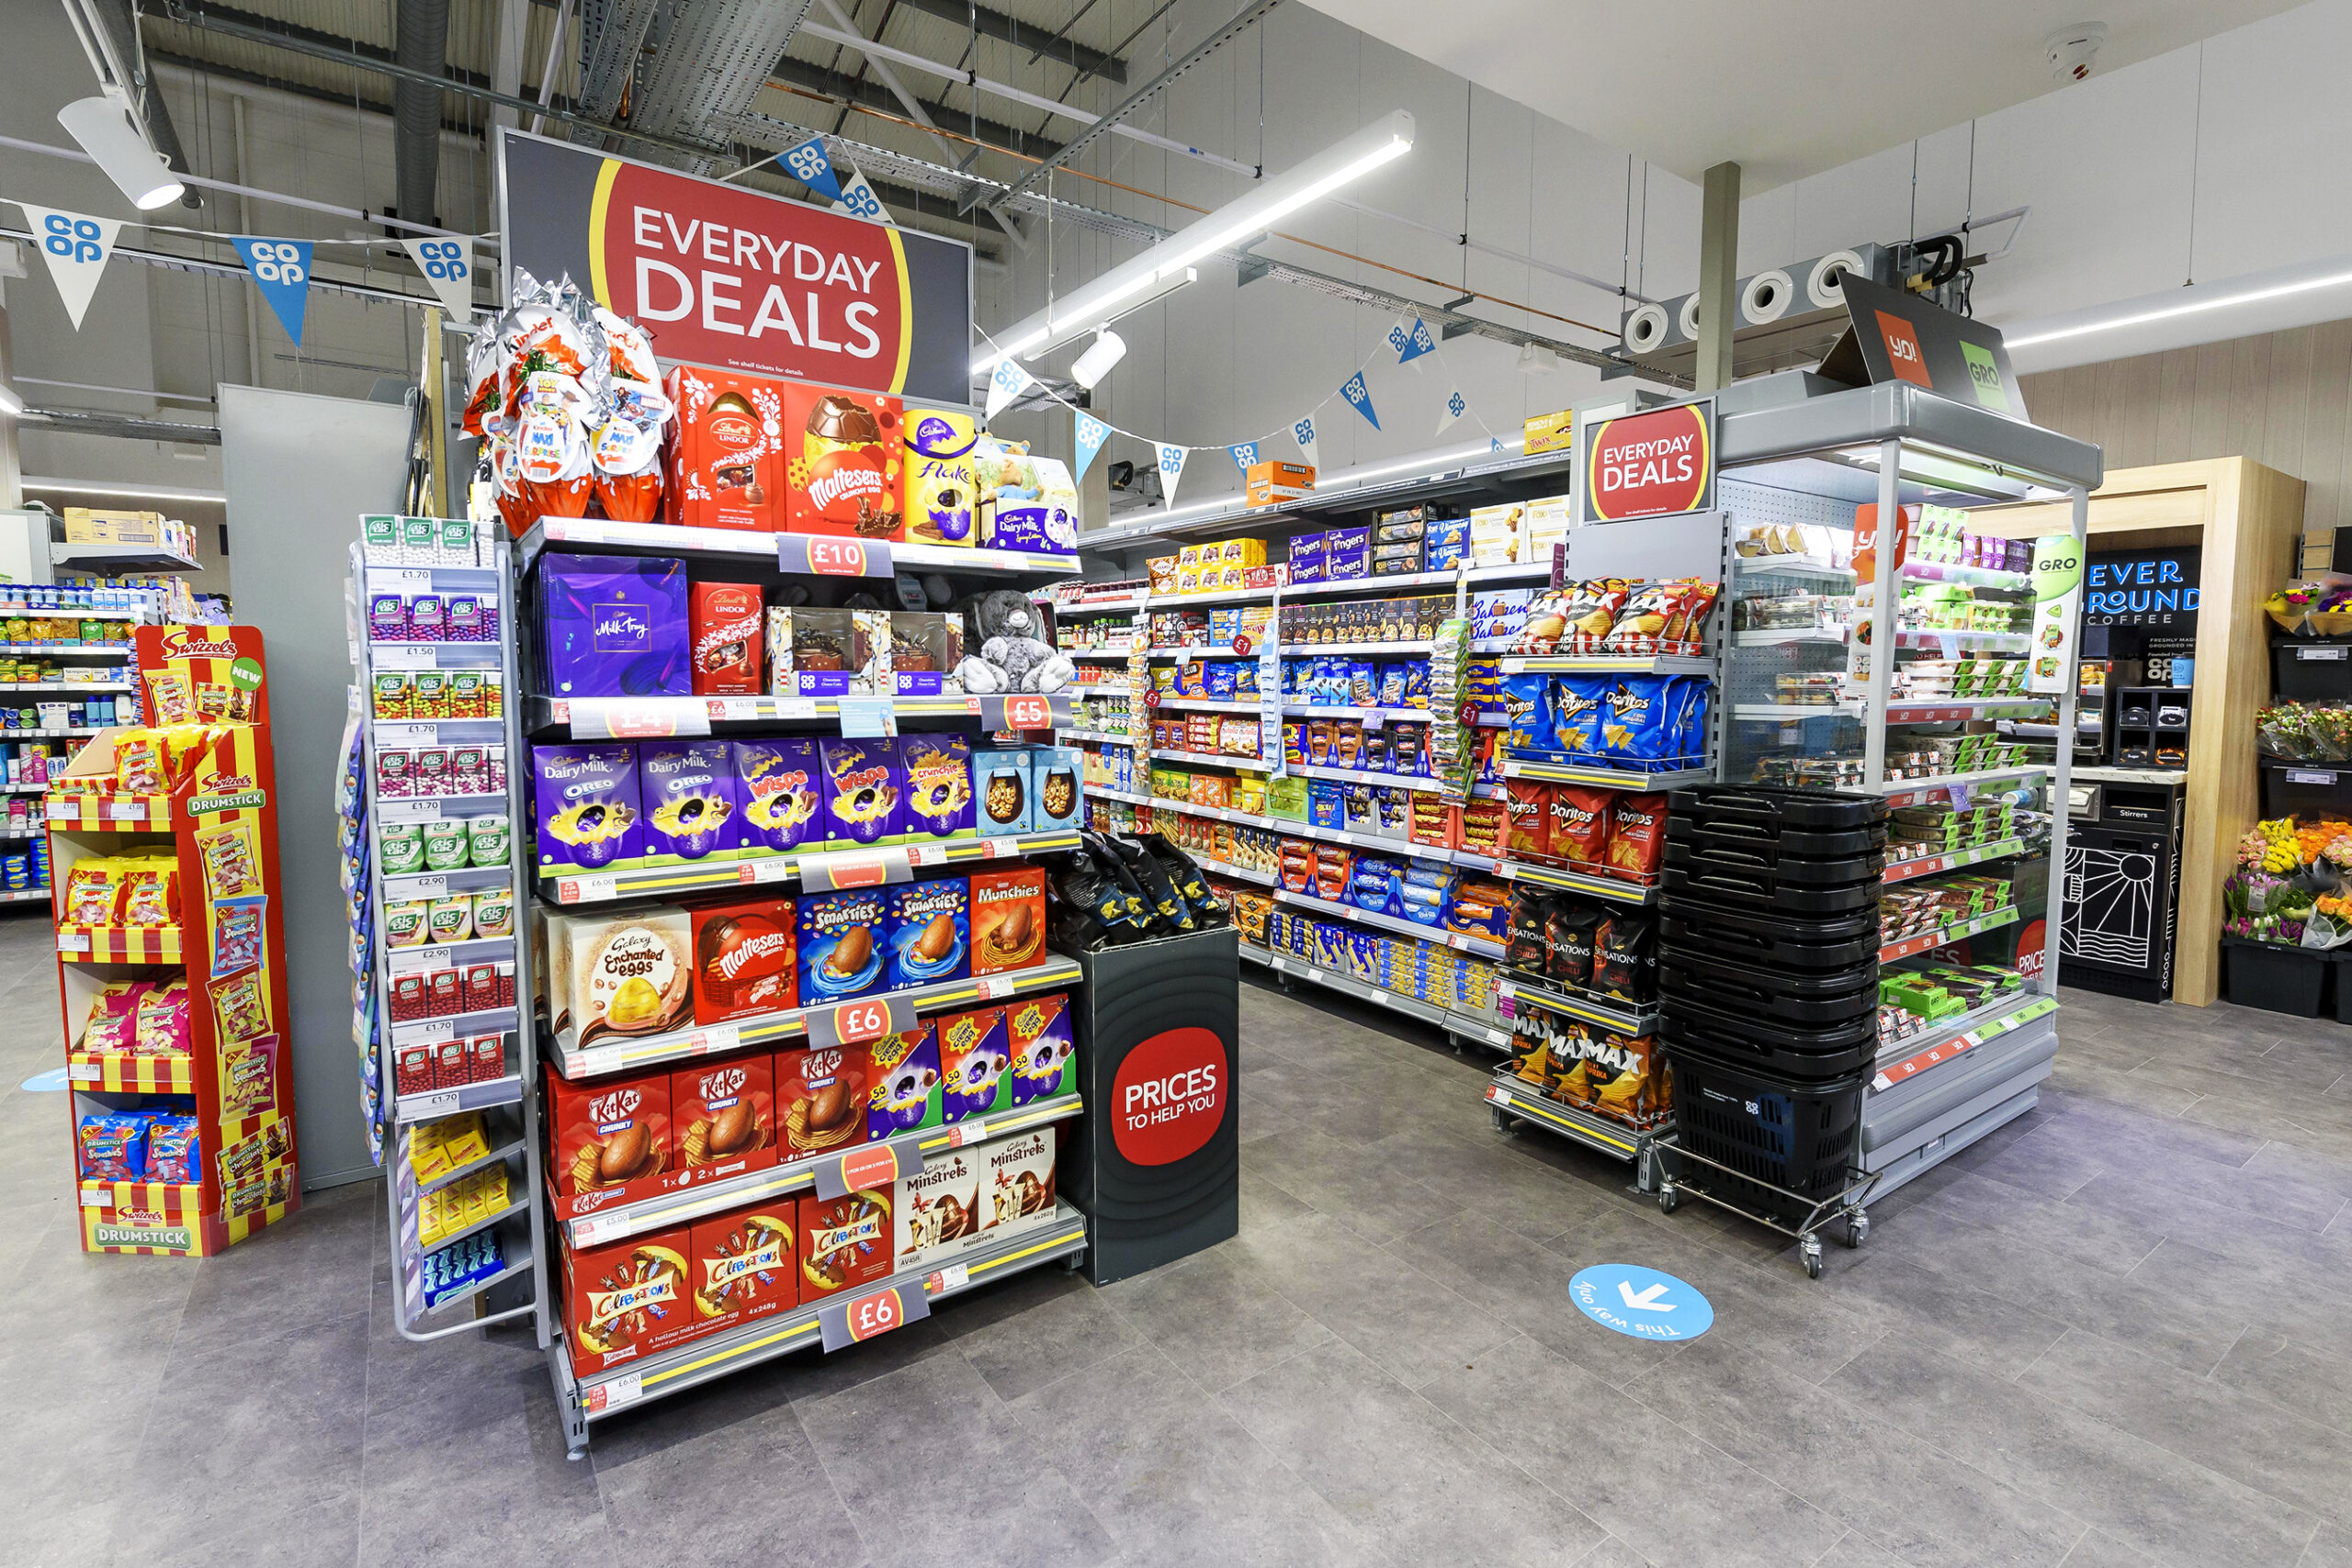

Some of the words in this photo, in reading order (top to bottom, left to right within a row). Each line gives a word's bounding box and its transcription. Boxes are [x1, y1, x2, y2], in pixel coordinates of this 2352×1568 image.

[634, 206, 881, 294] EVERYDAY
[636, 256, 881, 359] DEALS
[1970, 362, 1998, 386] GRO
[537, 378, 557, 388] TOY
[531, 433, 554, 446] MAXI
[719, 434, 749, 445] LINDOR
[1604, 434, 1694, 464] EVERYDAY
[1603, 455, 1692, 491] DEALS
[808, 468, 881, 511] Maltesers
[1000, 521, 1021, 533] Dairy
[814, 543, 859, 565] £10
[2040, 558, 2076, 570] GRO
[2089, 560, 2183, 586] EVER
[715, 605, 746, 614] LINDOR
[2081, 588, 2199, 614] ROUND
[595, 620, 622, 636] Milk
[622, 616, 649, 639] Tray
[2087, 615, 2172, 625] COFFEE
[162, 631, 237, 660] Swizzels
[1235, 639, 1248, 651] £1
[232, 667, 261, 683] NEW
[1183, 665, 1197, 674] CLUB
[1147, 694, 1158, 705] £1
[1607, 692, 1650, 709] Doritos
[710, 705, 725, 714] £6
[1013, 702, 1042, 722] £5
[1463, 706, 1476, 722] £1
[544, 766, 581, 779] Dairy
[581, 759, 613, 773] Milk
[649, 761, 680, 773] Dairy
[682, 755, 711, 769] Milk
[201, 773, 253, 793] Swizzels
[192, 795, 261, 812] DRUMSTICK
[1551, 803, 1594, 823] Doritos
[2120, 809, 2147, 818] Stirrers
[210, 840, 242, 855] DRUMSTICK
[419, 877, 444, 886] £2.90
[224, 916, 254, 927] DRUMSTICK
[612, 934, 652, 952] Galaxy
[424, 950, 448, 958] £2.90
[719, 931, 785, 979] Maltesers
[1610, 975, 1630, 984] CHILLI
[425, 1022, 451, 1031] £1.70
[846, 1008, 881, 1032] £6
[1586, 1039, 1643, 1074] MAX
[808, 1078, 835, 1089] CHUNKY
[1125, 1064, 1216, 1112] PRICES
[432, 1094, 457, 1103] £1.70
[708, 1098, 738, 1110] CHUNKY
[1125, 1114, 1148, 1131] TO
[1151, 1102, 1185, 1124] HELP
[1189, 1093, 1216, 1114] YOU
[599, 1121, 631, 1134] CHUNKY
[991, 1143, 1045, 1168] Minstrels
[907, 1165, 967, 1191] Minstrels
[117, 1206, 162, 1223] Swizzels
[98, 1229, 186, 1245] DRUMSTICK
[655, 1331, 678, 1342] hollow
[680, 1325, 695, 1335] milk
[695, 1315, 726, 1329] chocolate
[748, 1303, 776, 1314] 4x248g
[859, 1299, 892, 1330] £6
[1590, 1307, 1627, 1328] way
[1635, 1324, 1680, 1337] This
